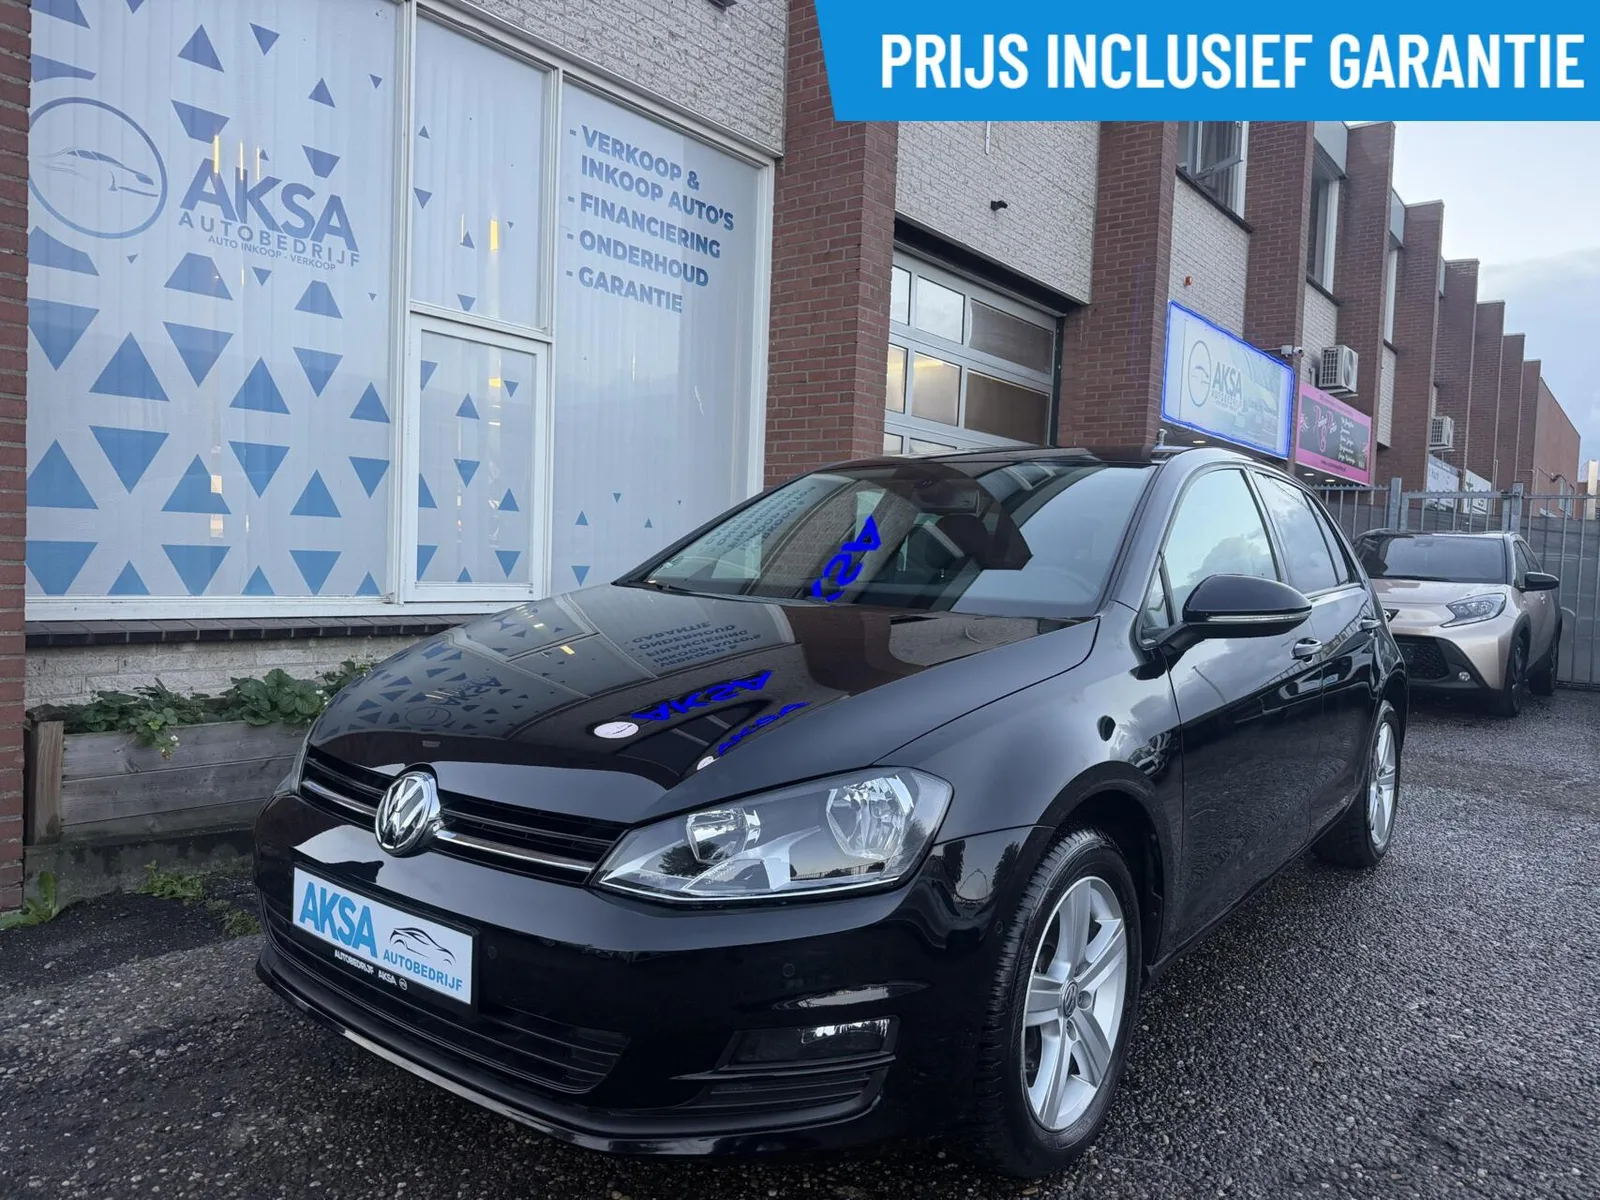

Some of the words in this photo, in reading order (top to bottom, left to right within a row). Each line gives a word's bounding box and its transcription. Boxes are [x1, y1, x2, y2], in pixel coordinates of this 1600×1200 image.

[582, 125, 682, 181] VERKOOP
[687, 170, 700, 191] &
[180, 158, 360, 252] AKSA
[581, 155, 663, 201] INKOOP
[667, 191, 734, 231] AUTO'S
[178, 211, 360, 268] AUTOBEDRIJF
[208, 235, 238, 249] AUTO
[241, 243, 282, 259] INKOOP
[290, 254, 336, 271] VERKOOP
[580, 191, 721, 259] FINANCIERING
[579, 229, 709, 287] ONDERHOUD
[579, 266, 683, 314] GARANTIE
[1211, 361, 1242, 401] AKSA
[299, 881, 378, 959] AKSA
[334, 949, 375, 975] AUTOBEDRIJF
[378, 970, 397, 986] AKSA
[383, 949, 463, 992] AUTOBEDRIJF
